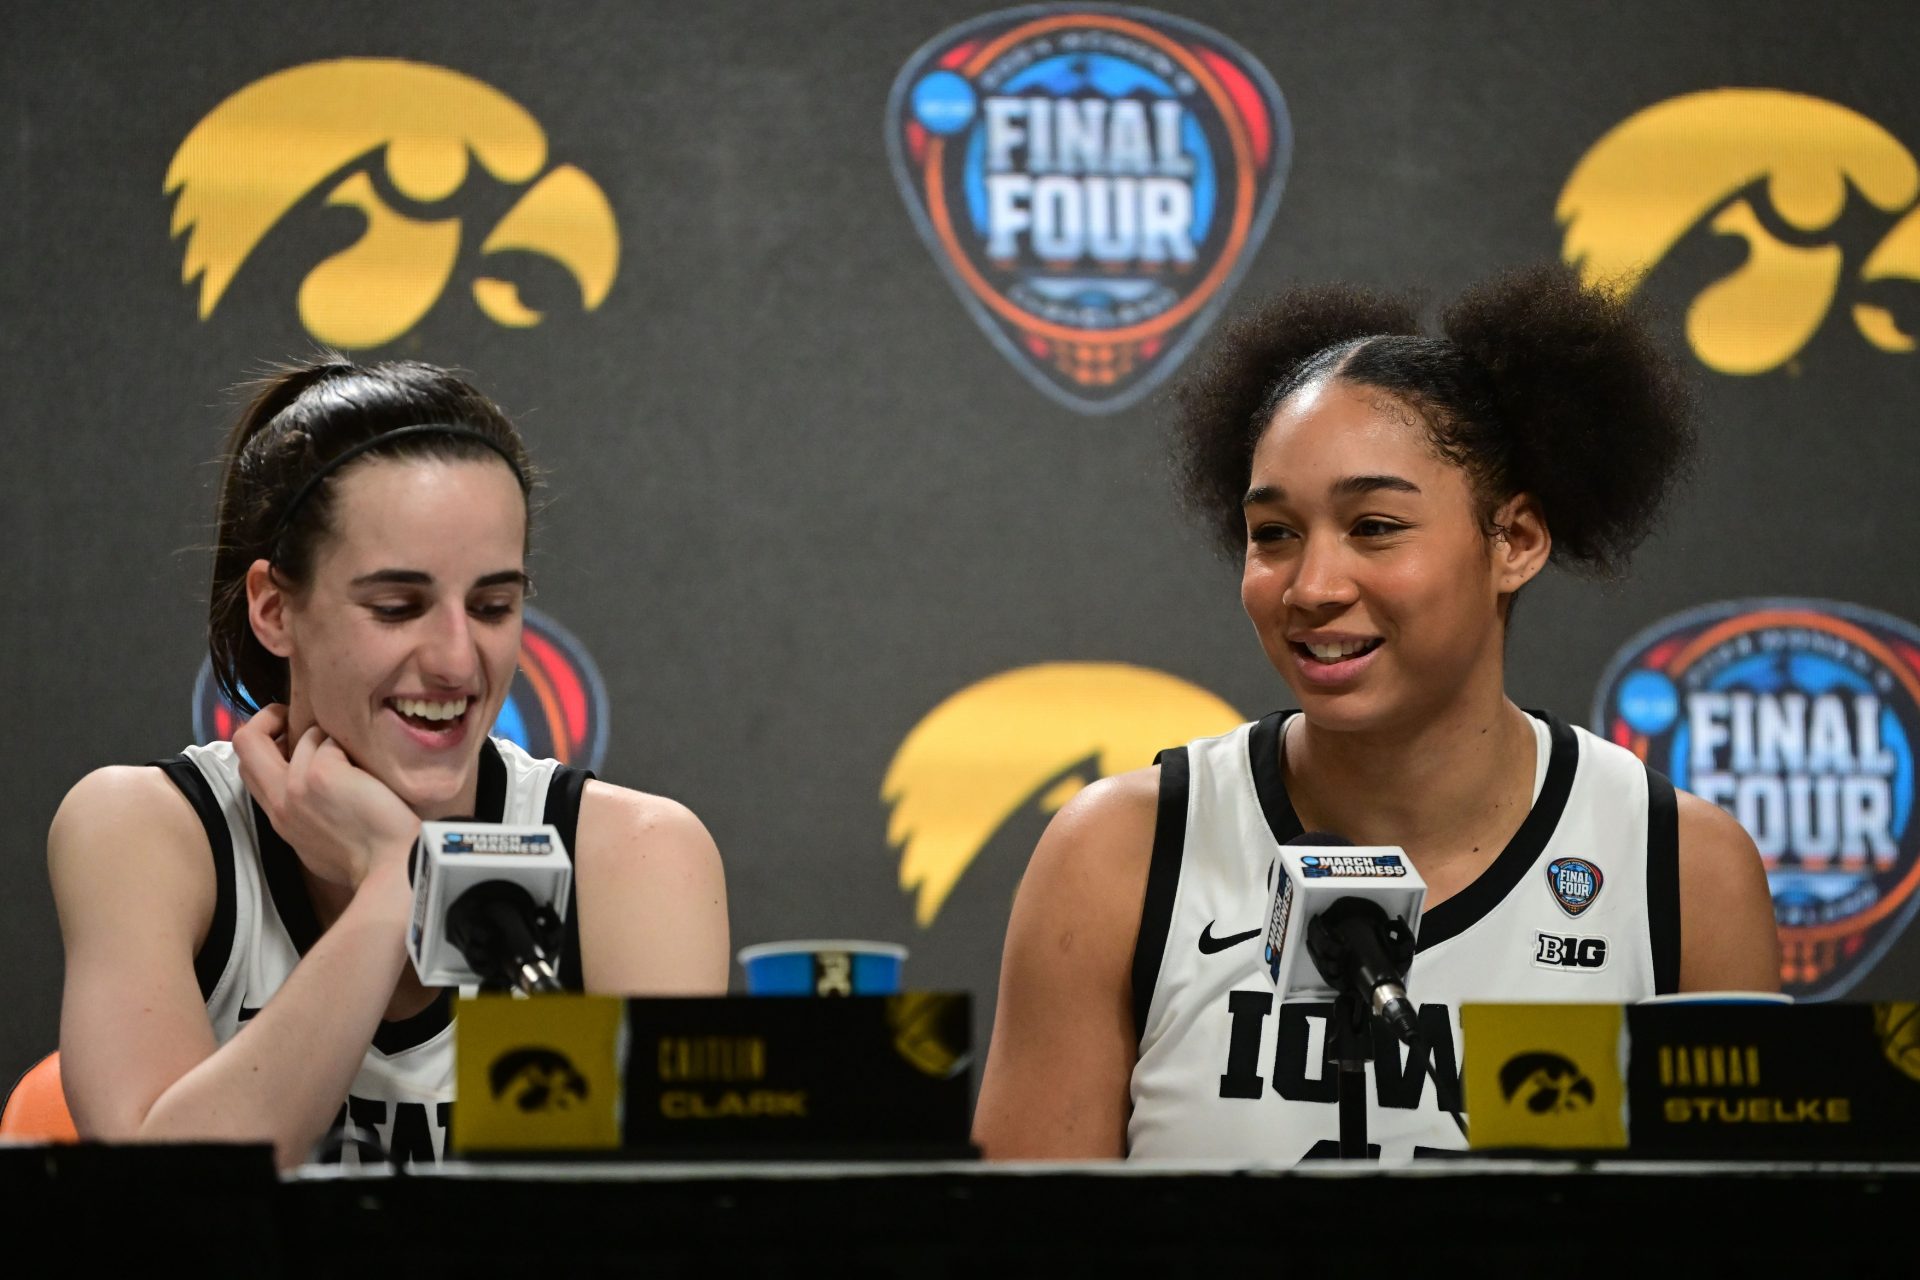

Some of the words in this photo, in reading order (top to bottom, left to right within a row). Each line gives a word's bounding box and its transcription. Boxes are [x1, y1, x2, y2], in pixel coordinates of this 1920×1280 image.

[985, 97, 1194, 174] FINAL
[987, 175, 1196, 263] FOUR
[1687, 693, 1895, 774] FINAL
[1318, 857, 1374, 867] MARCH
[1330, 865, 1406, 876] MADNESS
[1559, 880, 1590, 897] FOUR
[1560, 869, 1590, 885] FINAL
[1219, 990, 1465, 1112] IOW
[660, 1090, 808, 1119] CLARK
[1663, 1096, 1851, 1123] STUELKE
